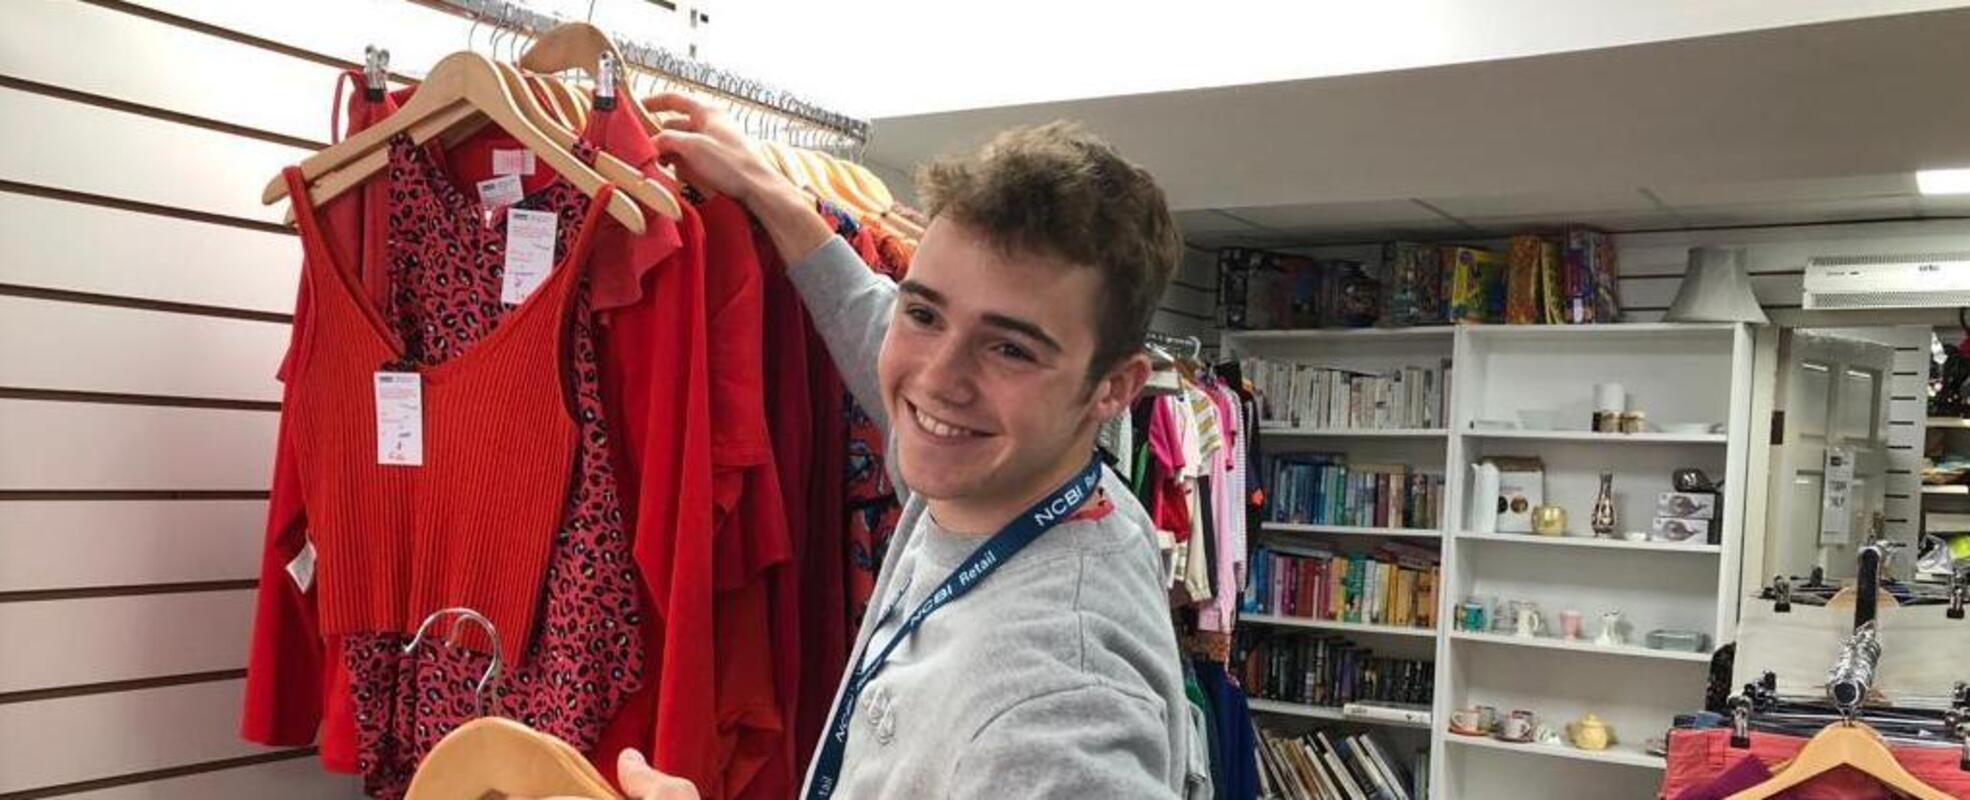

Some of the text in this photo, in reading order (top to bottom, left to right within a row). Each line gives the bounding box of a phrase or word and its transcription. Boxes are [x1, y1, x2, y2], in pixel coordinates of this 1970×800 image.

[1034, 484, 1084, 526] NCBI
[959, 549, 997, 586] Retail
[910, 584, 953, 628] NCBI
